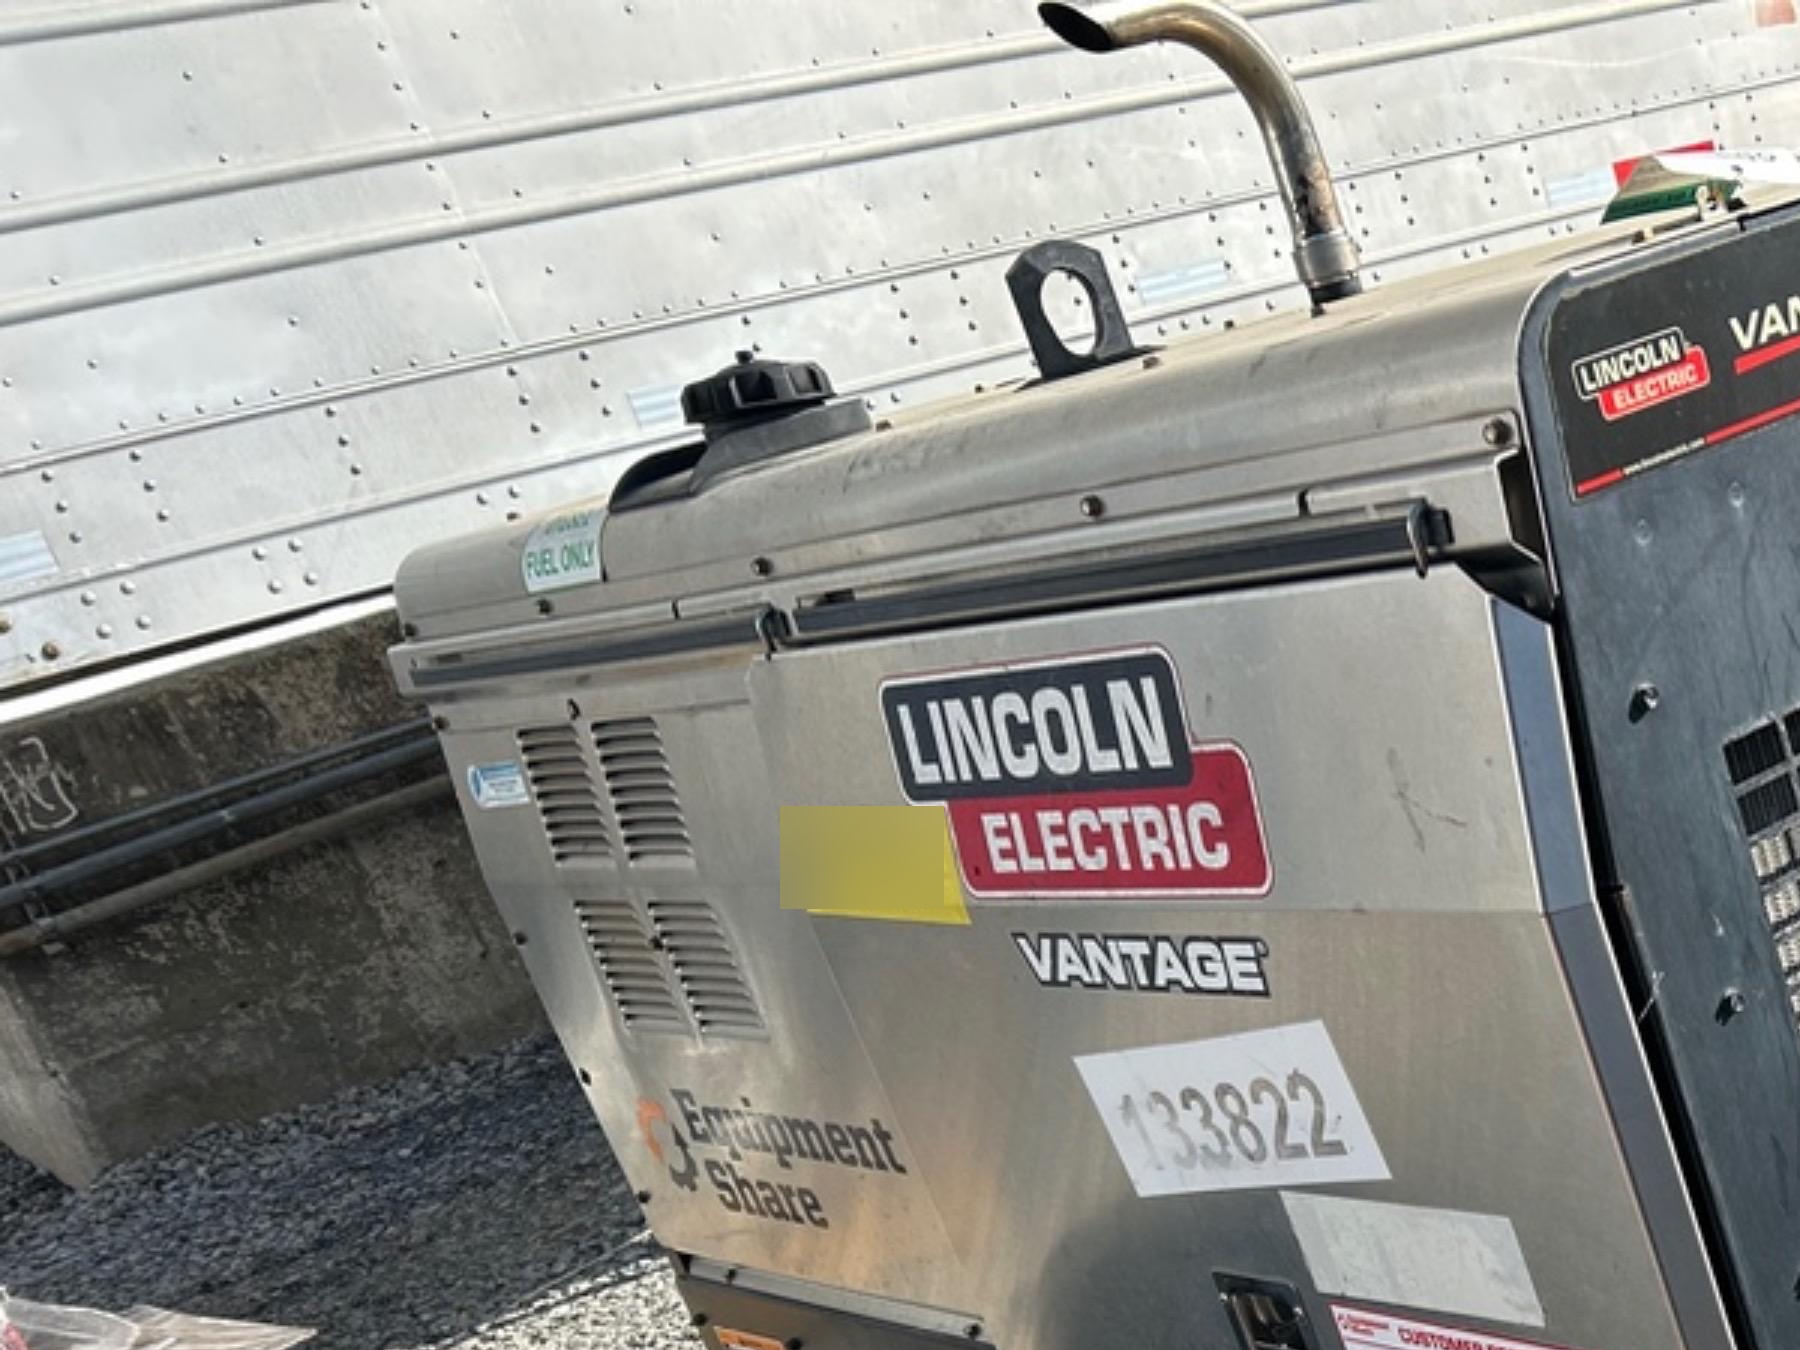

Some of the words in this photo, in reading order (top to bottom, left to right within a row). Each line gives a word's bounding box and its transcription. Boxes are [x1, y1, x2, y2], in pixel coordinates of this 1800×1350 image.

[1579, 334, 1682, 392] LINCOLN
[1613, 364, 1699, 409] ELECTRIC
[527, 548, 559, 578] FUEL
[560, 539, 594, 572] ONLY
[897, 676, 1175, 785] LINCOLN
[979, 802, 1231, 874] ELECTRIC
[1010, 932, 1270, 998] VANTAGE
[669, 1087, 908, 1175] Equipment
[1117, 1067, 1349, 1172] 133822
[703, 1158, 830, 1230] Share
